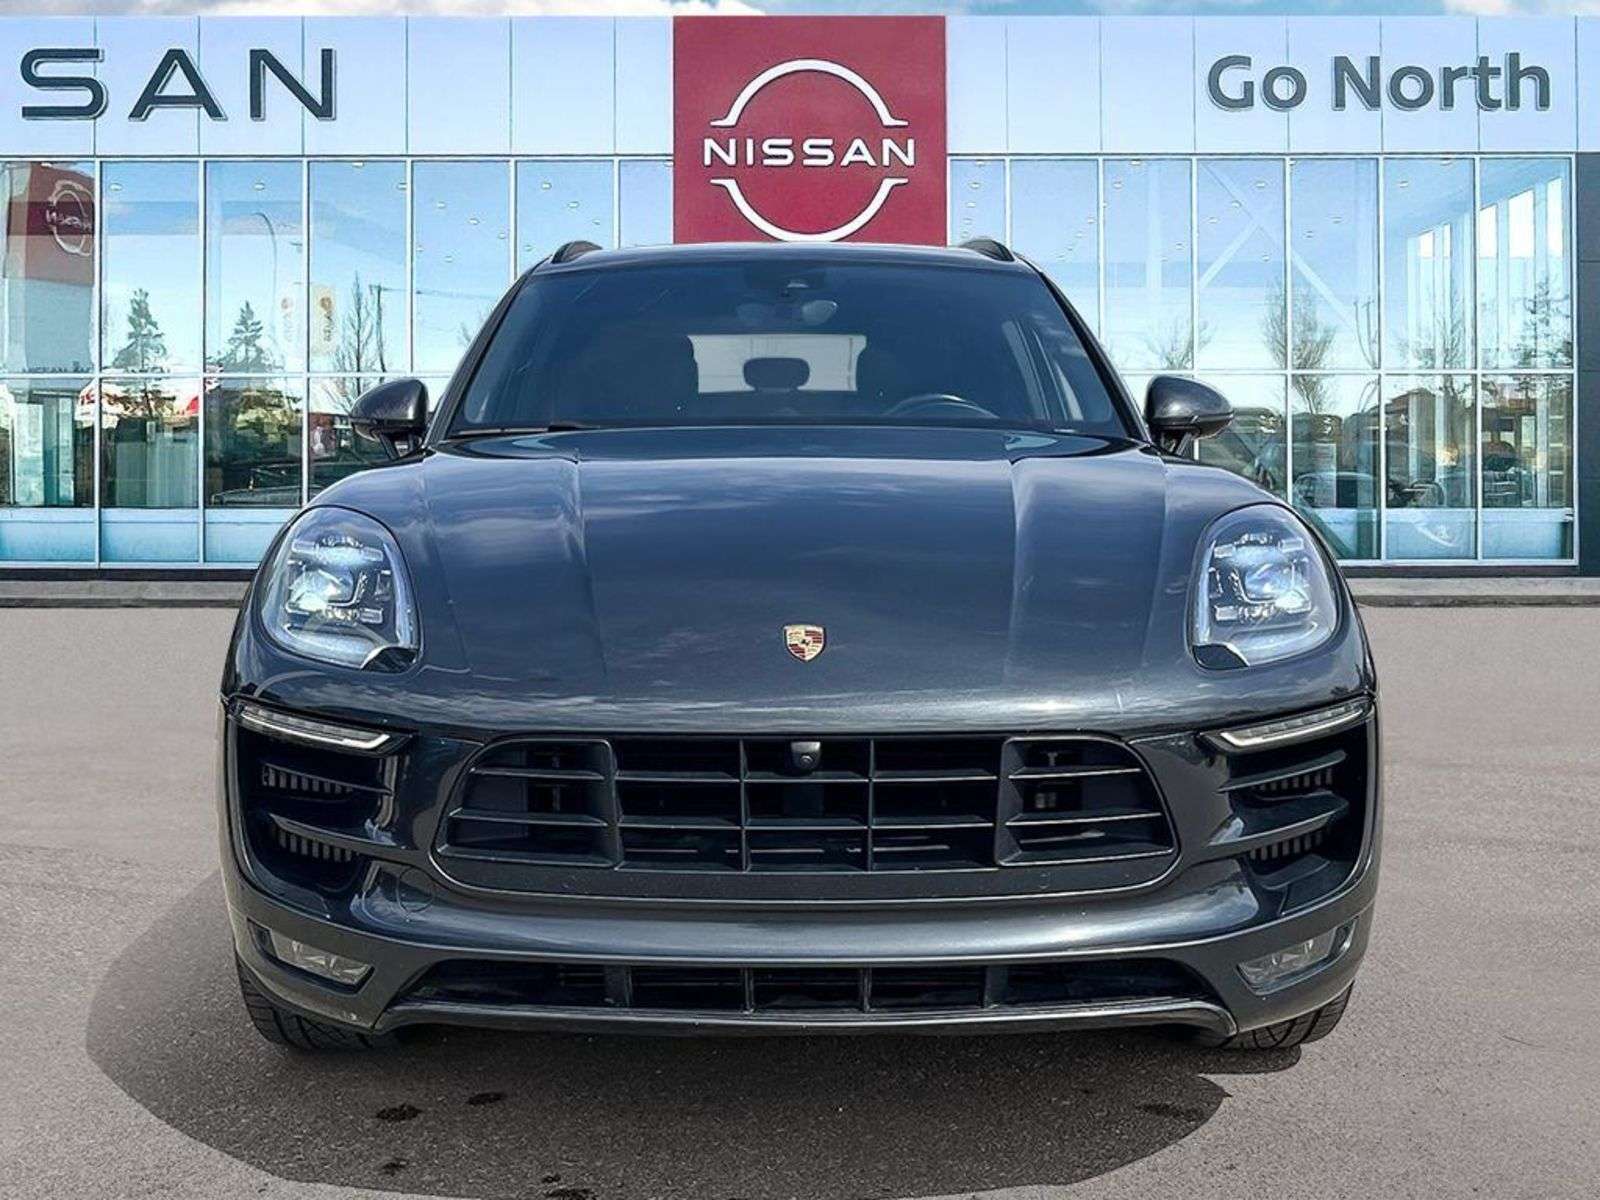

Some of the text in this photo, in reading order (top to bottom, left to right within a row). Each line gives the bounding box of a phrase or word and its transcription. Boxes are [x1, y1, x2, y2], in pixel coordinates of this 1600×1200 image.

[20, 47, 338, 121] SAN
[1207, 51, 1552, 112] Go North
[703, 137, 916, 167] NISSAN
